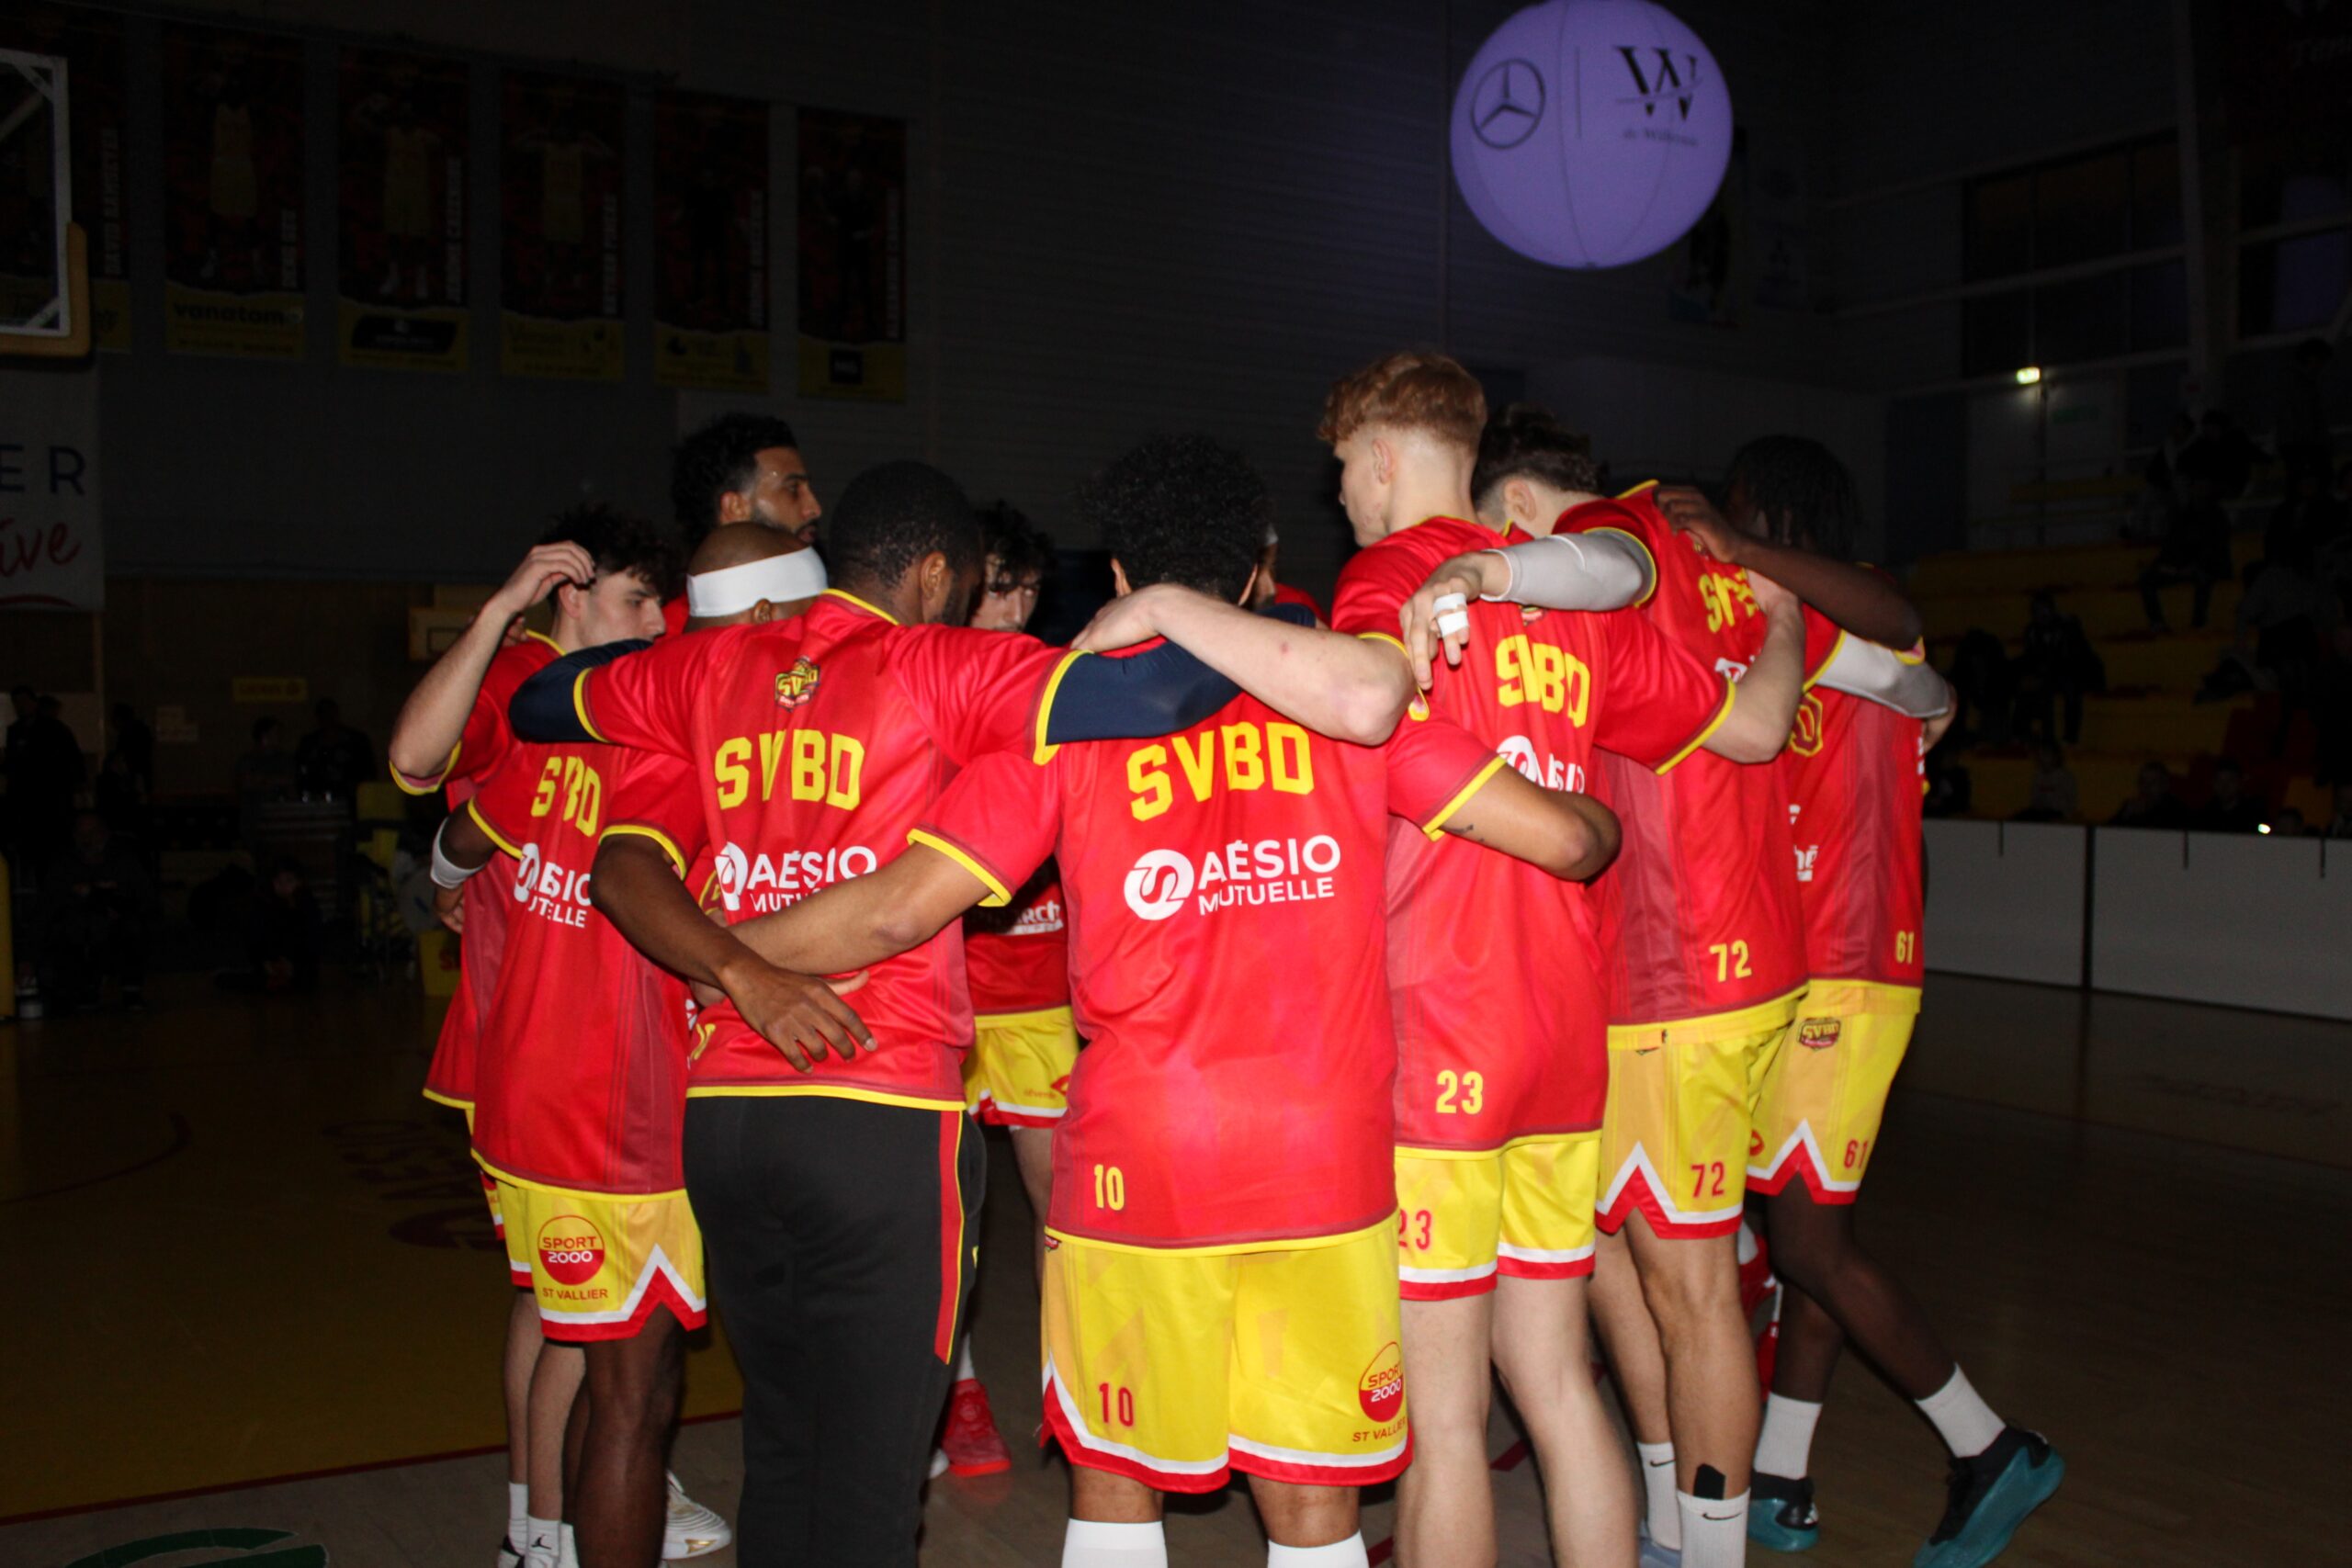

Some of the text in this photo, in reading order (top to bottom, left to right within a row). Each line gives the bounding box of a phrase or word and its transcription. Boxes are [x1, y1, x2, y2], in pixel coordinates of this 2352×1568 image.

[714, 728, 865, 811] SVBD
[1126, 720, 1315, 822] SVBD
[1197, 834, 1341, 890] AÉSIO
[1198, 877, 1335, 916] MUTUELLE
[1709, 940, 1752, 983] 72
[1895, 930, 1915, 964] 61
[1436, 1069, 1484, 1115] 23
[1844, 1139, 1868, 1169] 61
[1093, 1164, 1125, 1211] 10
[1691, 1161, 1724, 1198] 72
[543, 1236, 596, 1249] SPORT
[548, 1250, 594, 1264] 2000
[543, 1287, 608, 1301] ST VALLIER
[1099, 1382, 1134, 1427] 10
[1371, 1378, 1402, 1403] 2000
[1352, 1431, 1370, 1442] ST
